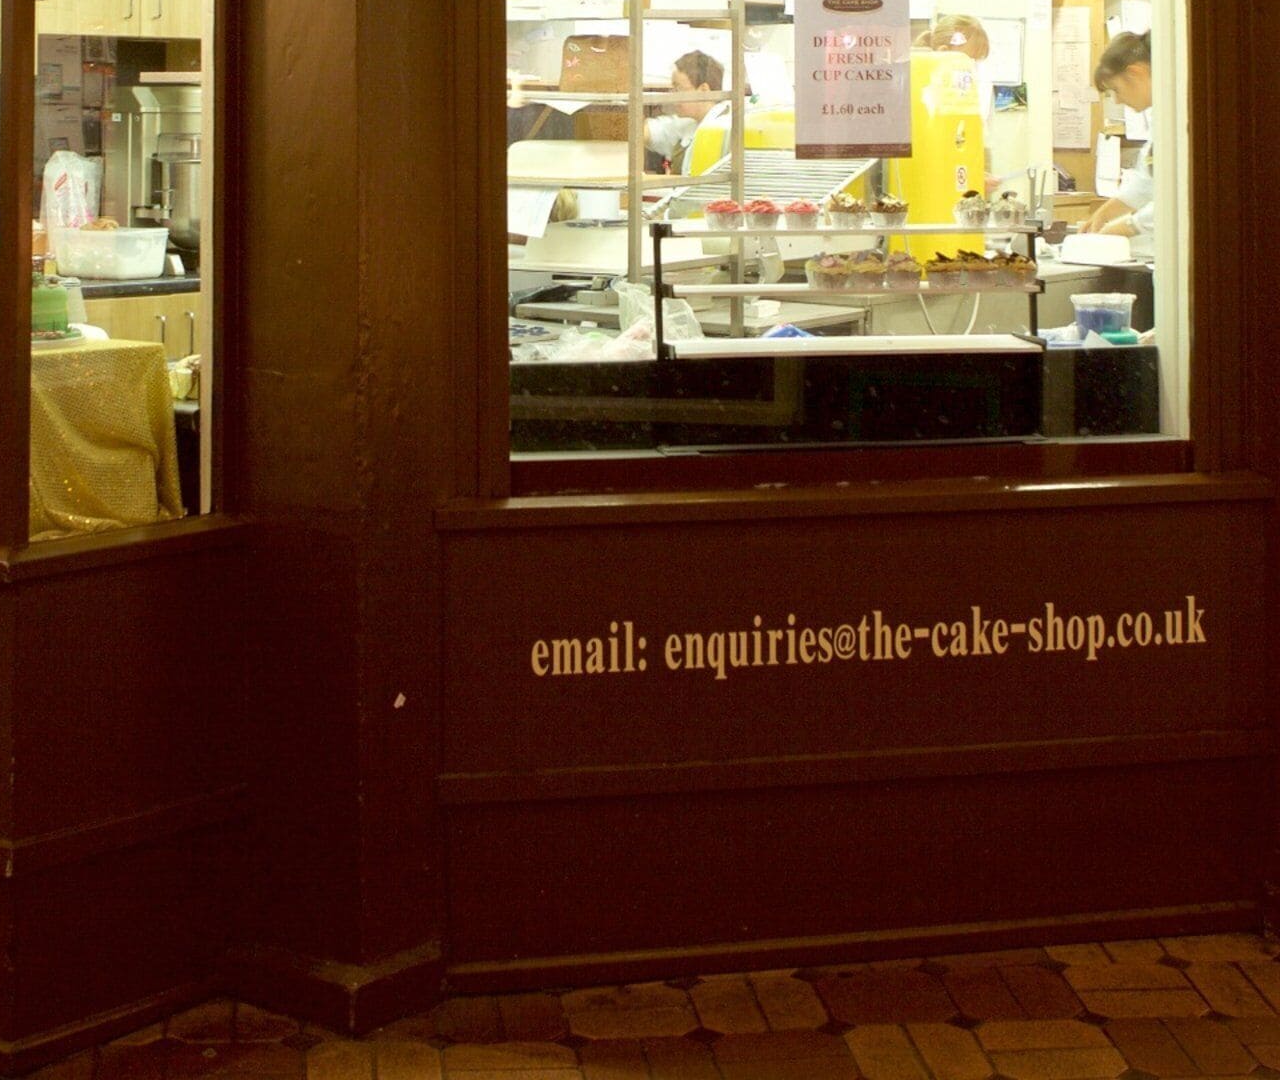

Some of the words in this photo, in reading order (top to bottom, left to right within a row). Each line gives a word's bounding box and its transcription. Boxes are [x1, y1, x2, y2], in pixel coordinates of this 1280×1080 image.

[812, 35, 893, 49] DELIOUS
[827, 52, 874, 65] FRESH
[812, 69, 841, 82] CUP
[844, 69, 894, 81] CAKES
[857, 103, 885, 115] each
[530, 620, 648, 677] email:
[663, 595, 1207, 680] enquiries@the-cake-shop.co.uk
